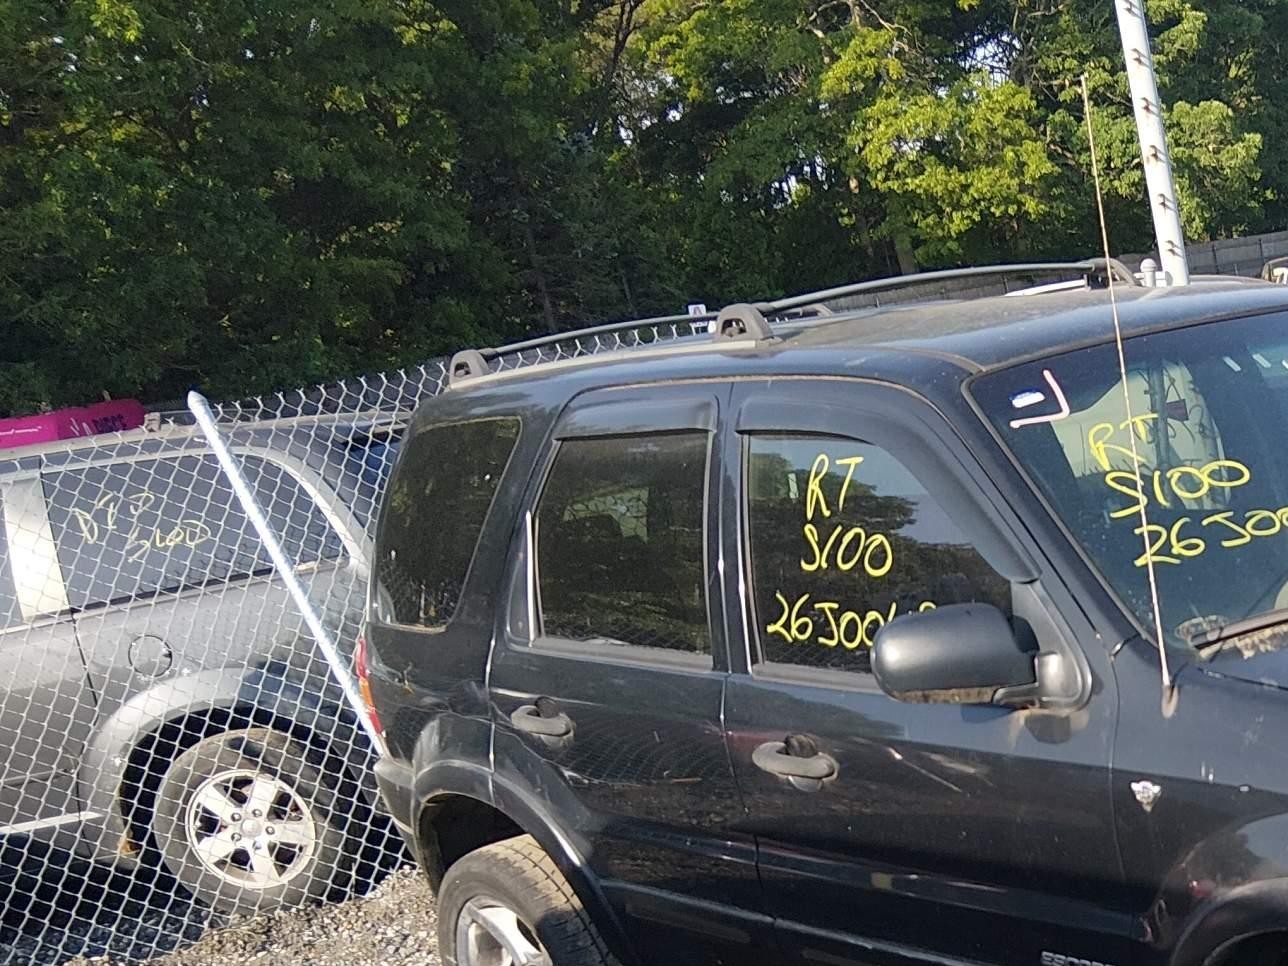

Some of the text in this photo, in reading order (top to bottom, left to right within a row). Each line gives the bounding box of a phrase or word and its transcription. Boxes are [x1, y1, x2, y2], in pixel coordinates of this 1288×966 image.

[1088, 412, 1159, 471] RT
[806, 453, 864, 520] RT
[1105, 459, 1250, 518] S100
[801, 523, 893, 577] S100
